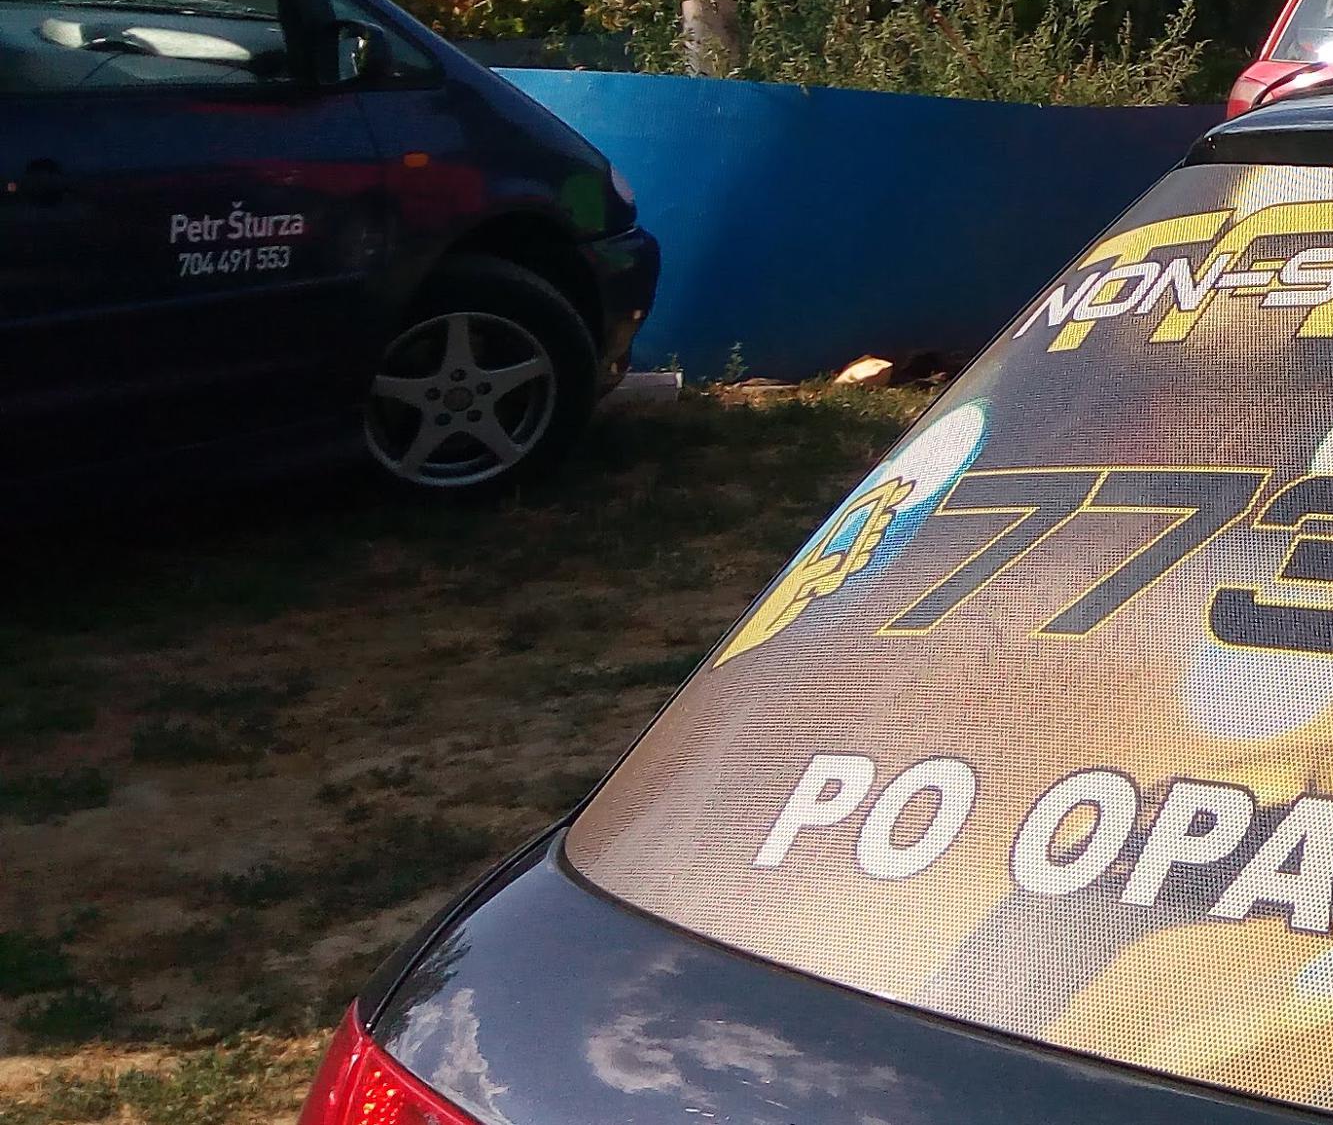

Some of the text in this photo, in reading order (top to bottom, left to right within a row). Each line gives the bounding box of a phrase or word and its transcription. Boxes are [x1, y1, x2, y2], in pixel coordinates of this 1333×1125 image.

[170, 200, 304, 243] Petr Šturza
[178, 245, 291, 276] 704 491 553
[752, 753, 979, 881] PO
